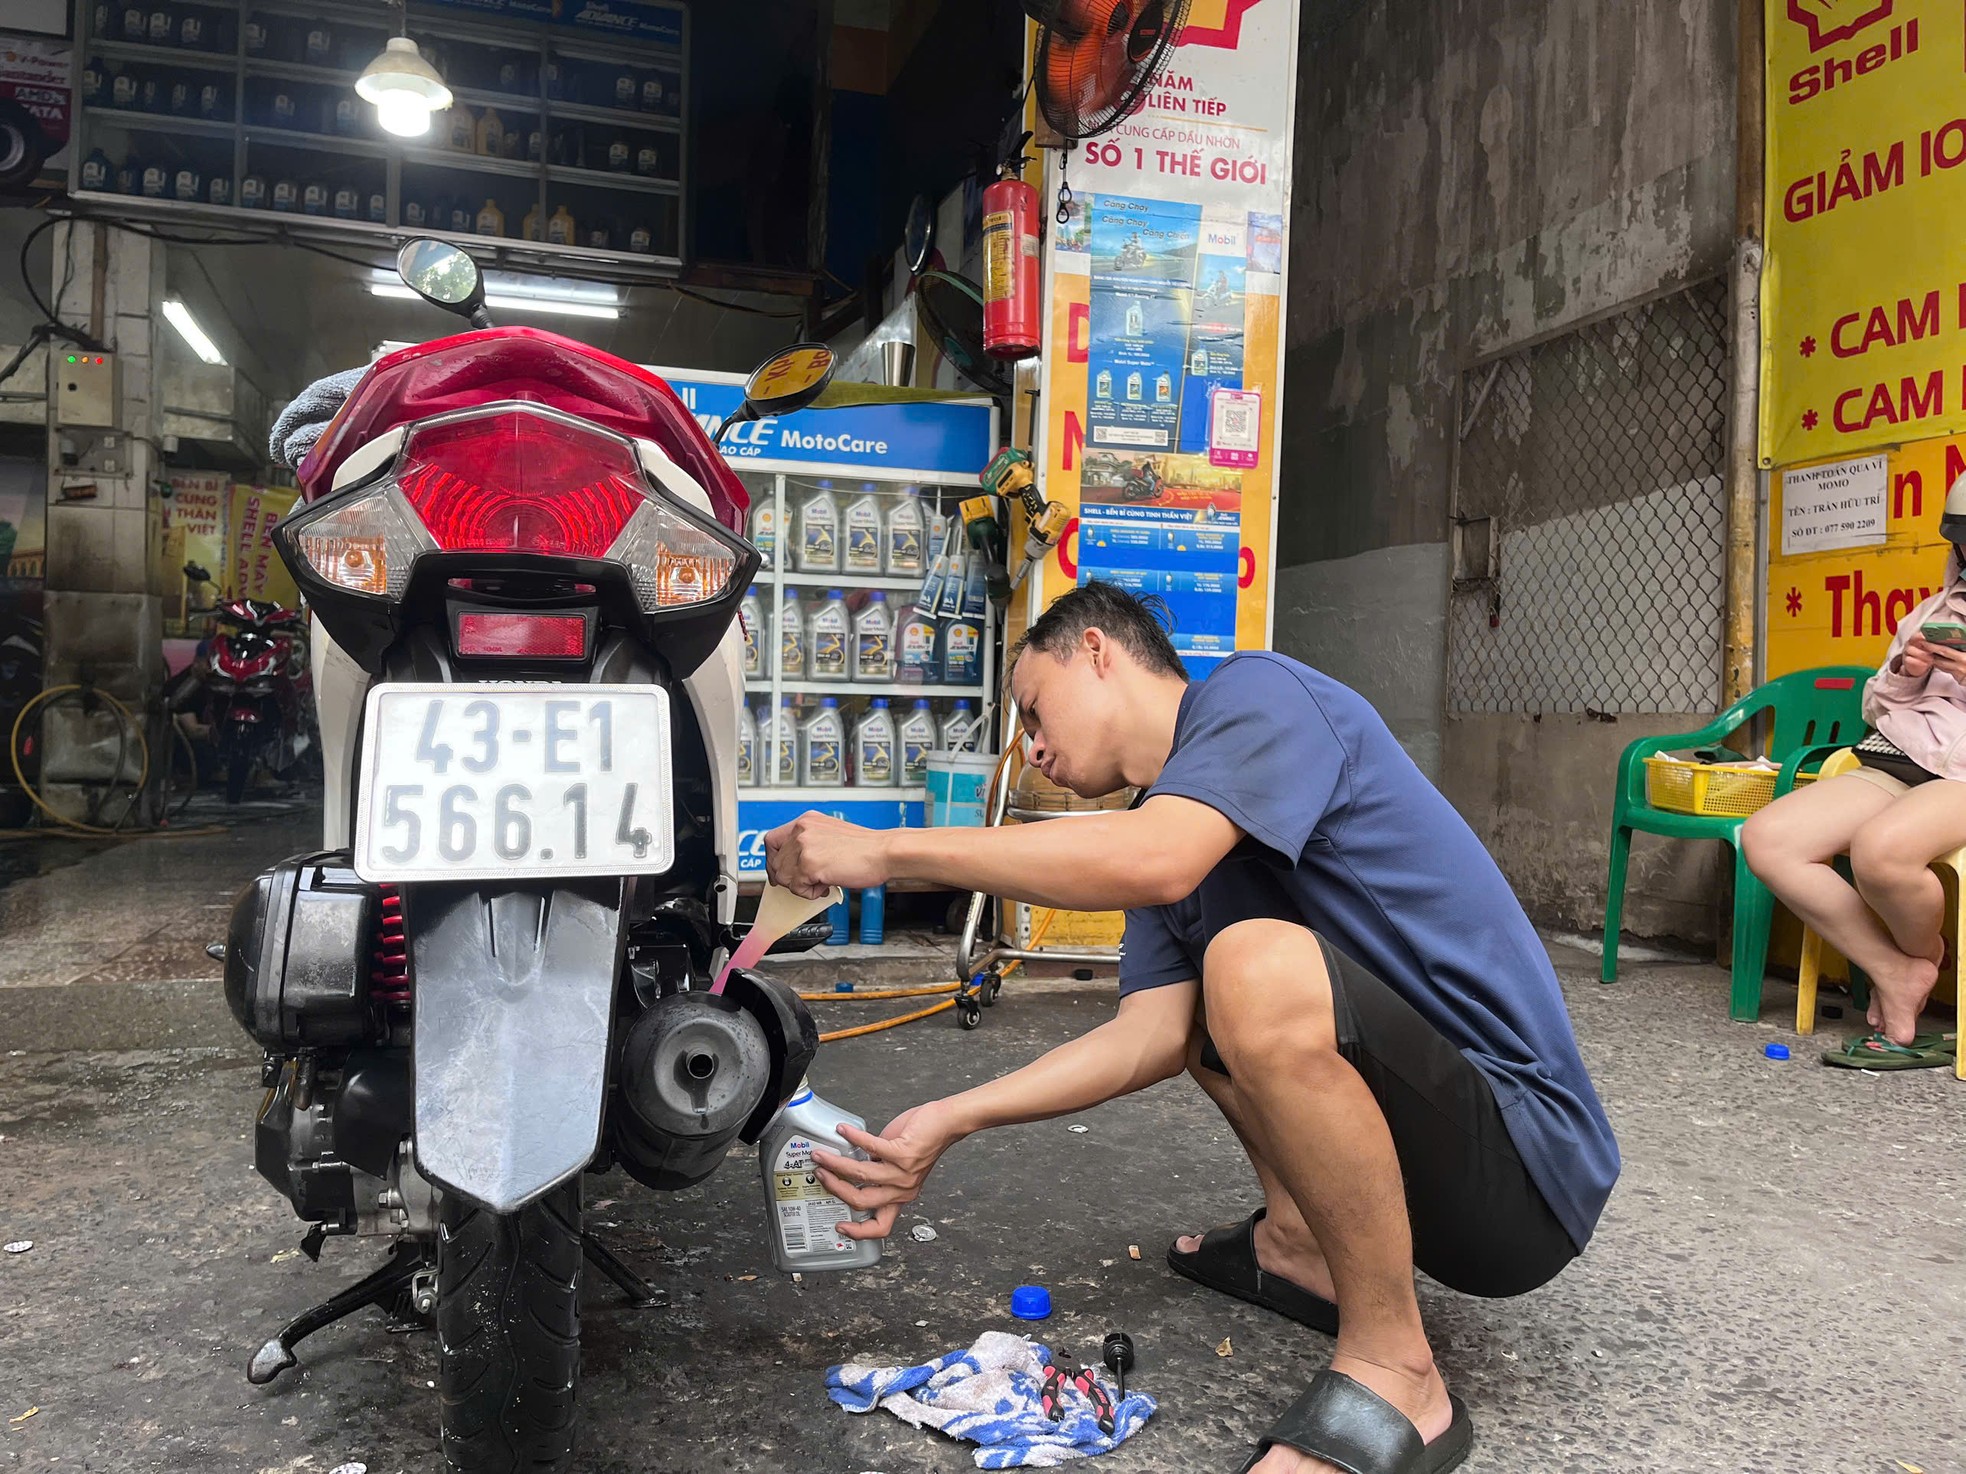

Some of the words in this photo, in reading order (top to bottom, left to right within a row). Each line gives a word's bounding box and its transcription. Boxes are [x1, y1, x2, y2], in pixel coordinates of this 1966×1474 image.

[1788, 17, 1919, 106] Shell
[1148, 91, 1186, 112] LIÊN
[1192, 96, 1227, 117] TIẾP
[1116, 124, 1150, 138] CUNG
[1085, 137, 1123, 168] SỐ
[1134, 147, 1143, 170] 1
[1156, 147, 1204, 177] THẾ
[1210, 155, 1267, 185] GIỚI
[1783, 140, 1904, 224] GIẢM
[1207, 233, 1237, 246] Mobil
[1830, 290, 1940, 359] CAM
[1832, 370, 1943, 433] CAM
[780, 429, 889, 455] MotoCare
[1787, 472, 1818, 486] THANH
[1849, 463, 1870, 476] QUA
[1818, 479, 1850, 491] MOMO
[239, 496, 261, 552] SHELL
[1788, 505, 1806, 517] TÊN
[1824, 521, 1839, 534] 077
[1840, 519, 1855, 531] 590
[1857, 517, 1876, 530] 2209
[415, 699, 614, 774] 43-E1
[380, 782, 653, 862] 566.14
[790, 1141, 810, 1149] Mobil
